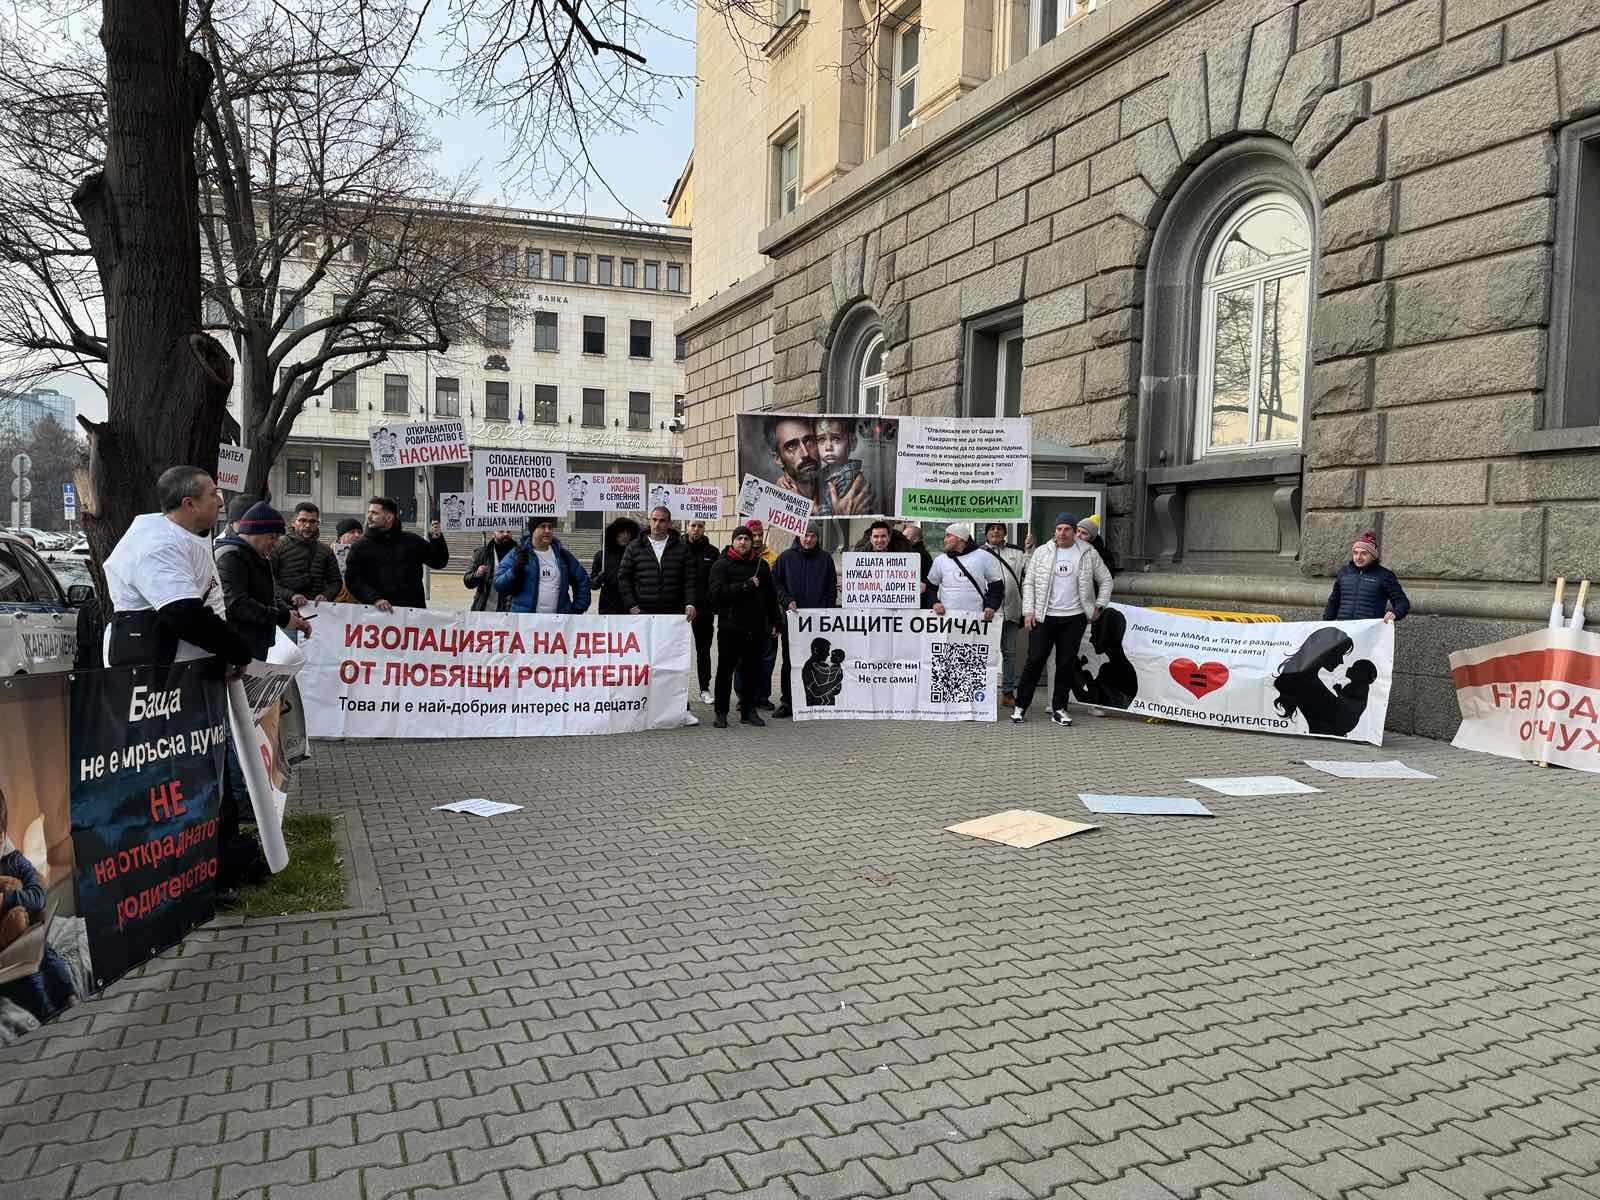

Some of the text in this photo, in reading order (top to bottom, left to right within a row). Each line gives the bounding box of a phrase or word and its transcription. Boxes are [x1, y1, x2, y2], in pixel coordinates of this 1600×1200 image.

[538, 294, 569, 304] БАНКА
[406, 422, 462, 436] ОТКРАДНАТОТО
[405, 432, 464, 445] РОДИТЕЛСТВО Е
[220, 449, 244, 463] ДИТЕЛ
[399, 443, 468, 464] НАСИЛИЕ
[489, 454, 552, 466] СПОДЕЛЕНОТО
[217, 471, 239, 484] АЦИЯ
[486, 466, 555, 478] РОДИТЕЛСТВО Е
[592, 476, 640, 485] БЕЗ ДОМАШНО
[487, 479, 556, 504] ПРАВО,
[600, 492, 640, 501] В СЕМЕЙНИЯ
[674, 487, 718, 496] БЕЗ ДОМАШНО
[616, 501, 640, 509] КОДЕКС
[764, 486, 810, 511] ОТЧУЖДАВАНЕТО
[908, 493, 1018, 506] И БАЩИТЕ ОБИЧАТ!
[487, 503, 555, 513] НЕ МИЛОСТИНЯ
[685, 503, 718, 512] СЕМЕЙНИЯ
[785, 503, 808, 518] НА ДЕТЕ
[465, 517, 474, 527] ОТ
[477, 517, 506, 527] ДЕЦАТА
[694, 511, 718, 520] КОДЕКС
[768, 507, 807, 535] УБИВА!
[856, 557, 907, 567] ДЕЦАТА ИМАТ
[846, 570, 916, 579] НУЖДА ОТ ТАТКО И
[847, 582, 855, 591] ОТ
[885, 582, 905, 591] ДОРИ
[908, 582, 916, 591] ТЕ
[847, 594, 916, 603] ДА СА РАЗДЕЛЕНИ
[799, 616, 993, 636] И БАЩИТЕ ОБИЧАТ
[344, 623, 640, 659] ИЗОЛАЦИЯТА НА ДЕЦА
[1131, 623, 1167, 636] Любовта
[1180, 631, 1210, 643] МАМА
[1219, 637, 1242, 646] ТАТИ
[1164, 640, 1200, 650] еднакво
[1201, 645, 1229, 653] важна
[1238, 648, 1266, 657] свята!
[854, 660, 921, 671] Потърсете ни!
[339, 660, 649, 692] ОТ ЛЮБЯЩИ РОДИТЕЛИ
[858, 674, 871, 683] Не
[889, 674, 917, 683] сами!
[129, 685, 182, 722] Баща
[339, 696, 648, 716] Това ли е най-добрия интерес на децата?
[1133, 699, 1289, 728] ЗА СПОДЕЛЕНО РОДИТЕЛСТВО
[80, 754, 104, 781] не
[109, 751, 119, 773] е
[149, 779, 187, 822] НЕ
[94, 856, 117, 885] на
